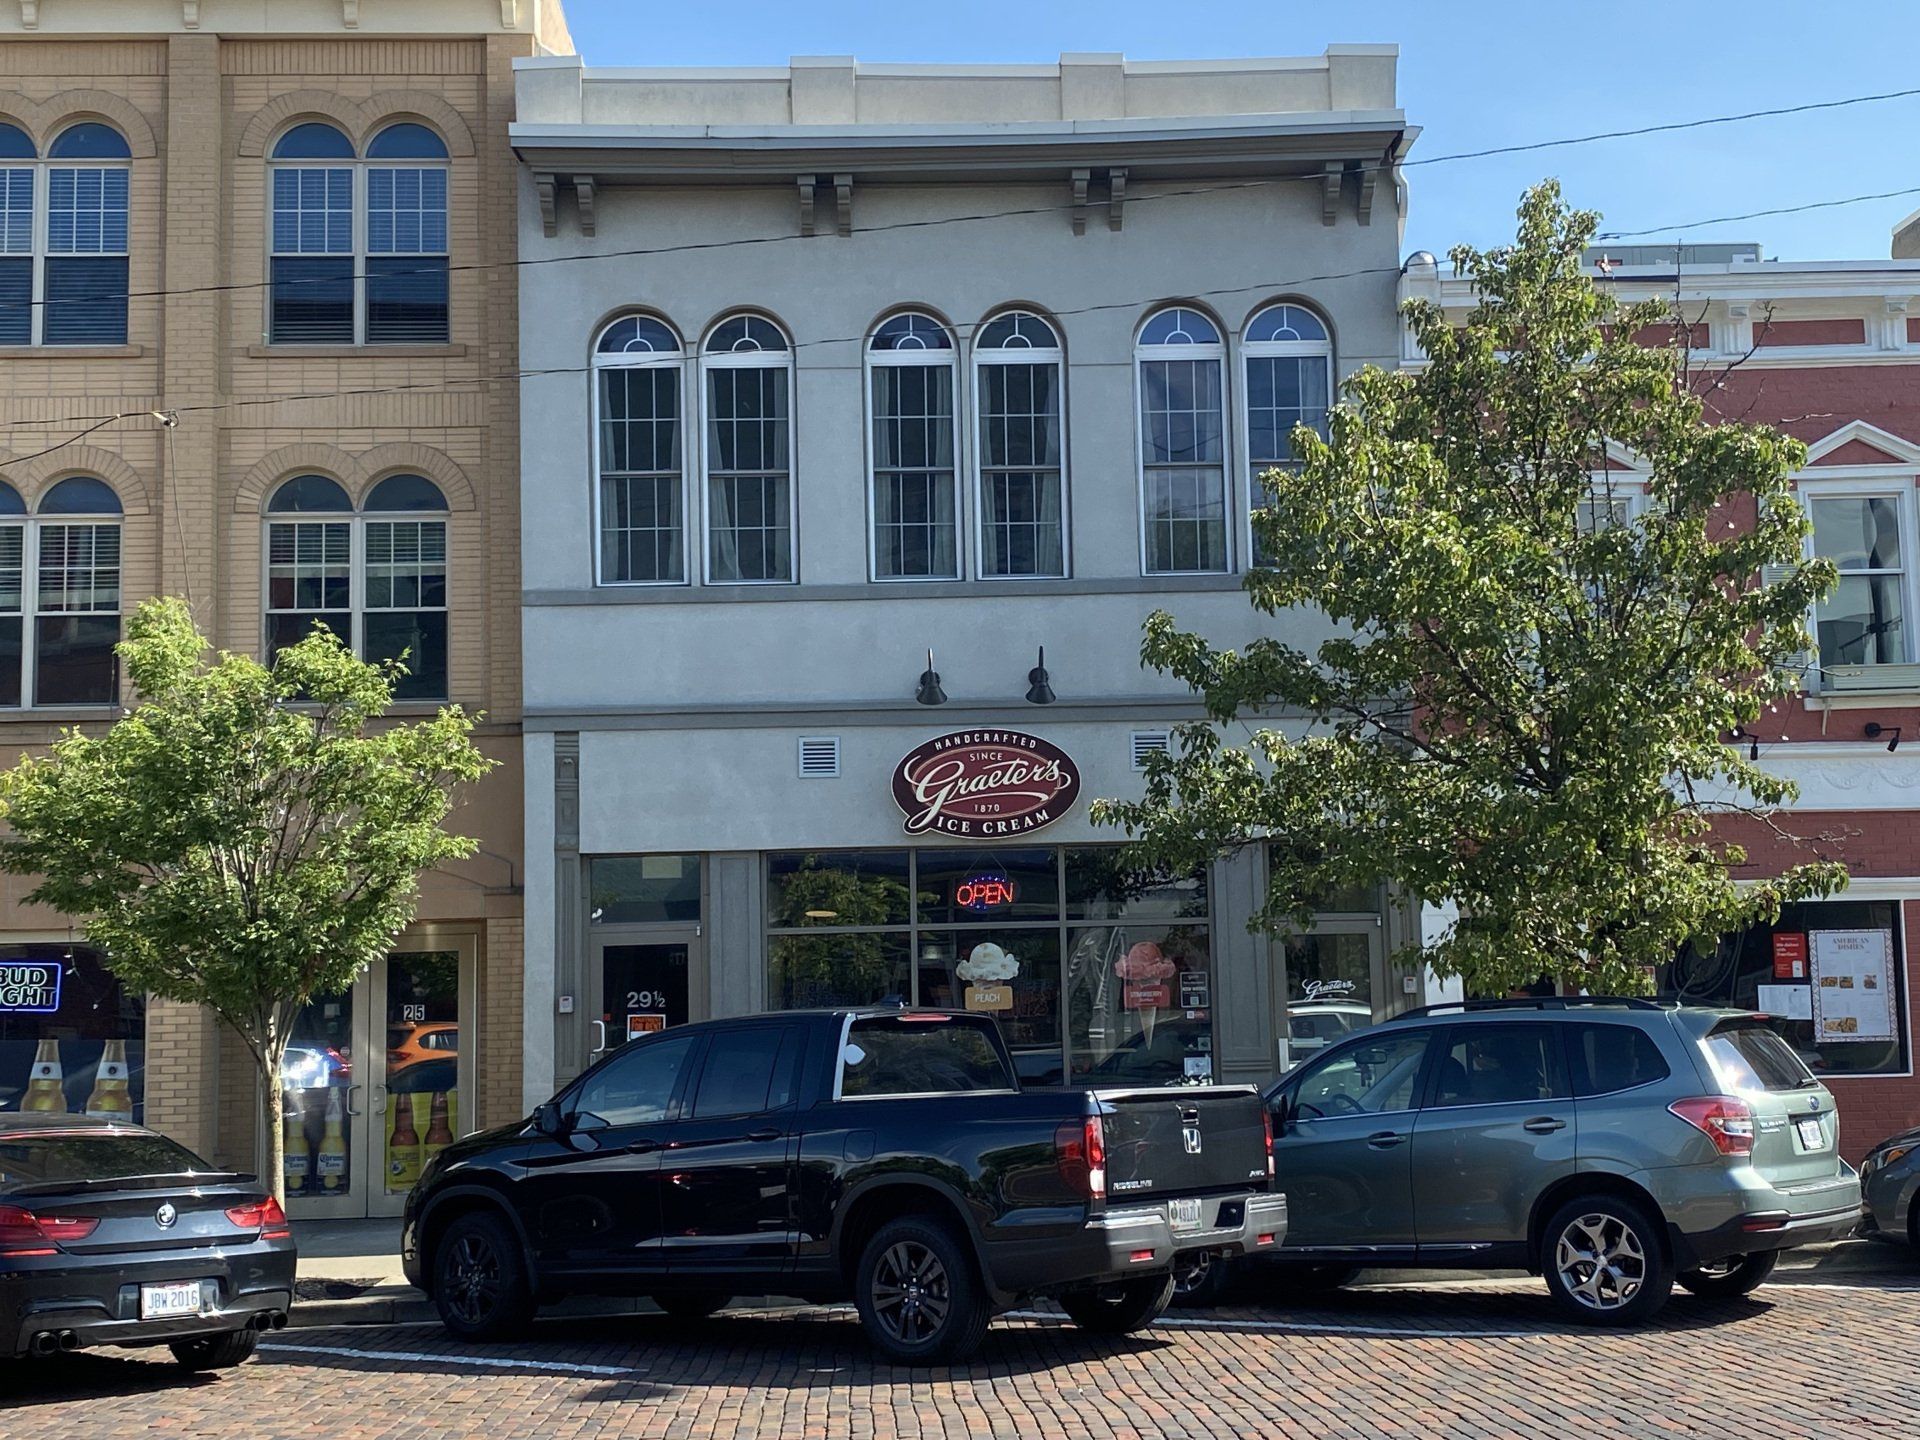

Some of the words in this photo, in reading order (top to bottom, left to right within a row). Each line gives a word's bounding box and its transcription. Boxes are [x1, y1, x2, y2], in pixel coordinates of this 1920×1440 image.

[935, 732, 1037, 750] HANDCRAFTED
[969, 752, 1003, 761] SINCE
[904, 754, 1072, 829] Graeter's
[974, 803, 1000, 813] 1870
[936, 815, 970, 833] ICE
[982, 809, 1050, 834] CREAM
[957, 882, 1013, 905] OPEN
[975, 993, 1000, 1003] PEACH
[406, 1005, 423, 1020] 25
[148, 1293, 168, 1309] JBW
[171, 1290, 198, 1308] 2016
